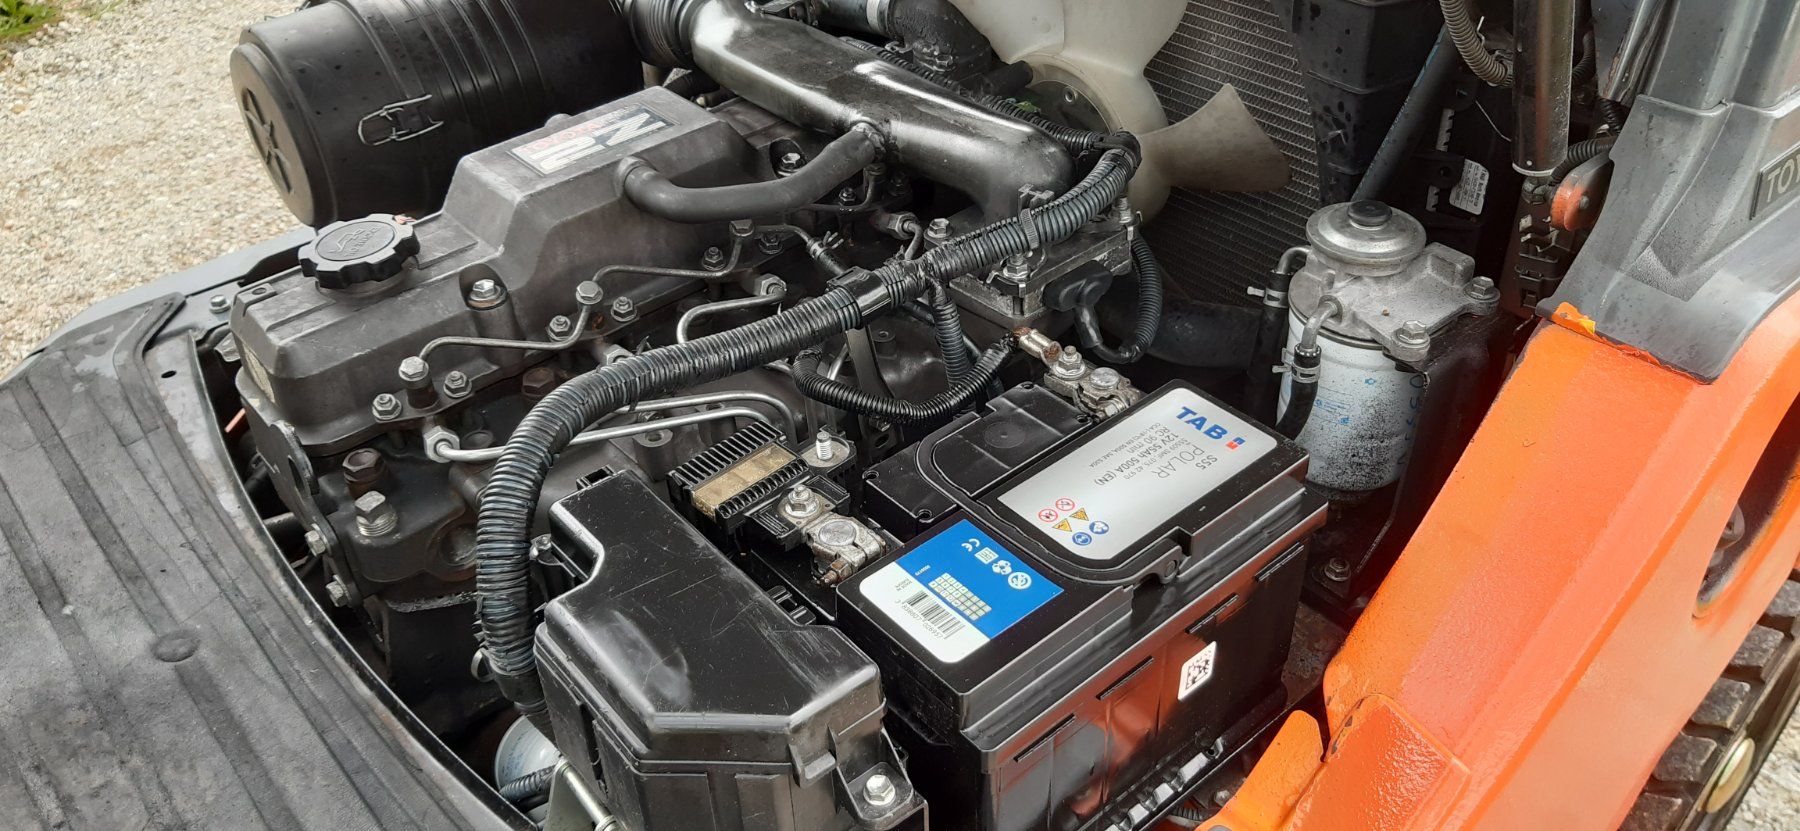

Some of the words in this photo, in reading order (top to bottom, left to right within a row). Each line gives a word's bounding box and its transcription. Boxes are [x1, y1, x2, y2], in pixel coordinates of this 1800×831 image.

[1177, 406, 1228, 440] TAB
[1143, 434, 1158, 444] 90
[1155, 426, 1170, 437] RC
[1161, 433, 1179, 445] 12V
[1126, 441, 1144, 454] min
[1137, 443, 1162, 458] 55Ah
[1114, 457, 1140, 473] 500A
[1151, 444, 1205, 478] POLAR
[1195, 454, 1218, 470] S55
[1094, 470, 1116, 485] (EN)
